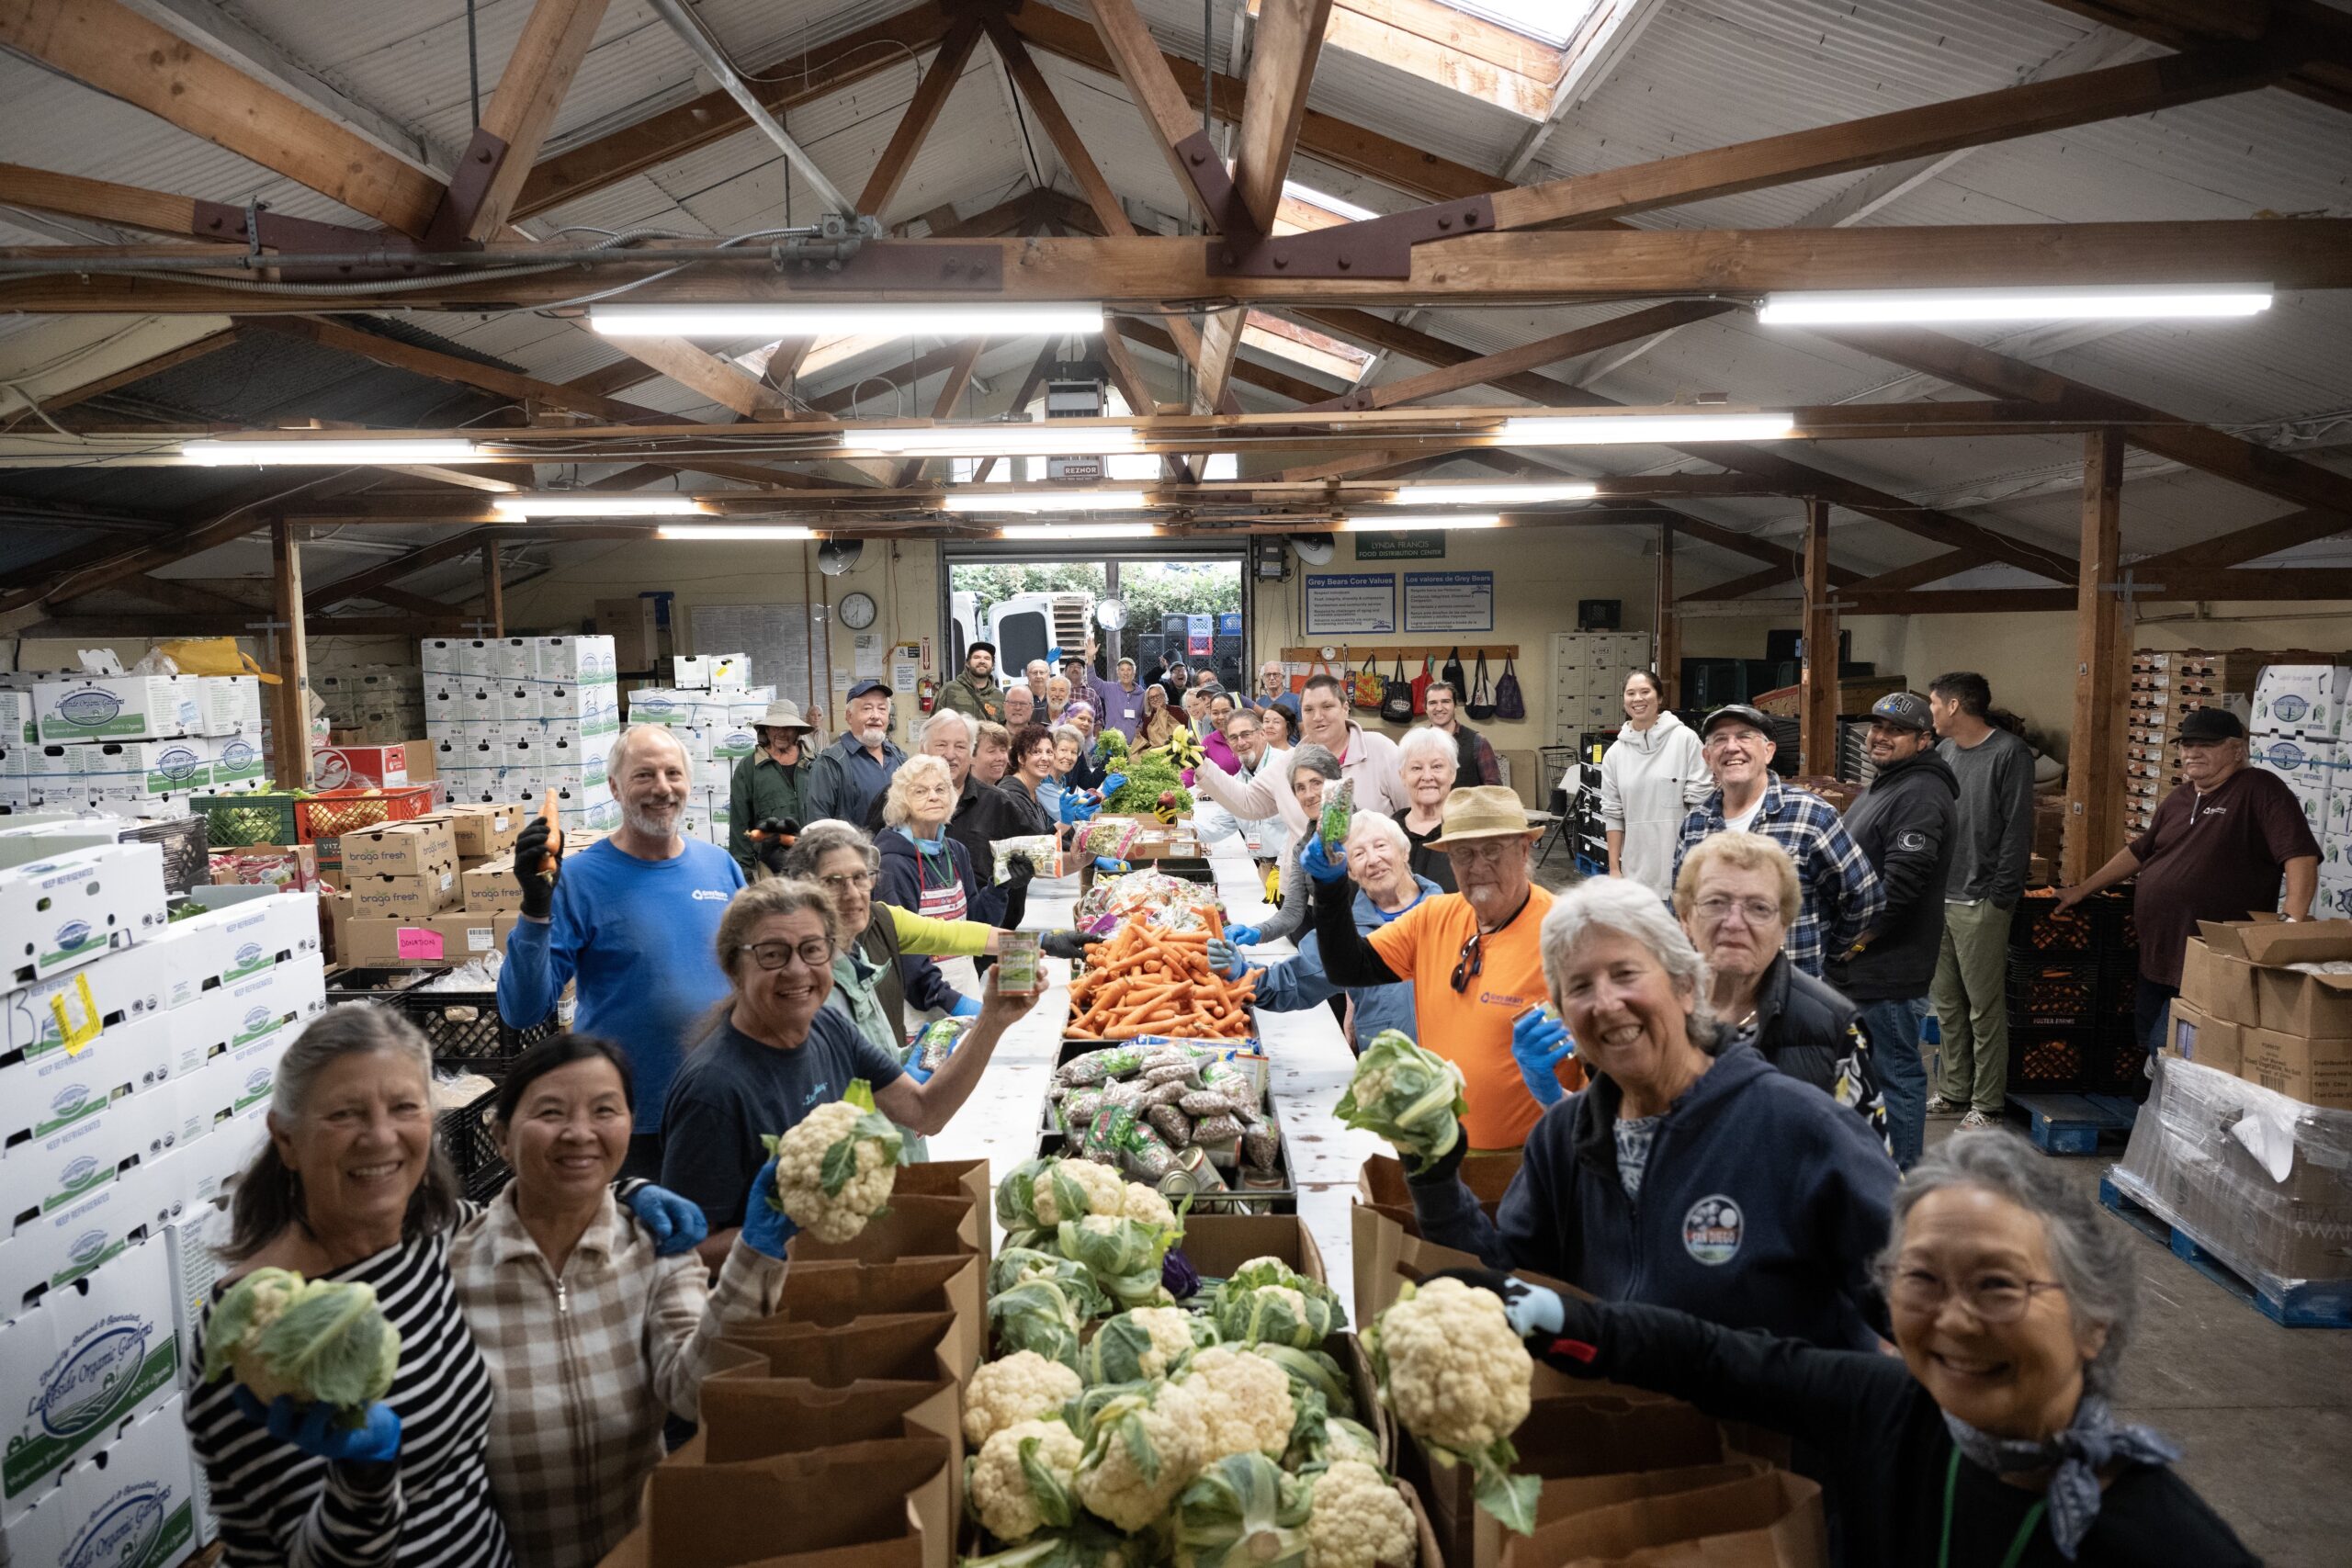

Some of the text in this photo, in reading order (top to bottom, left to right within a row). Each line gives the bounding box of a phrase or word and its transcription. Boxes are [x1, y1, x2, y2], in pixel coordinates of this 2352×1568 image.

[1308, 578, 1325, 586] Grey
[349, 851, 406, 865] braga fresh
[360, 892, 419, 907] braga fresh
[470, 889, 500, 902] braga
[401, 939, 435, 947] DONATION
[1692, 1231, 1736, 1244] SAN DIEGO
[26, 1320, 153, 1419] Lakeside Organic Gardens
[95, 1512, 134, 1559] Organic
[135, 1484, 172, 1529] Gardens
